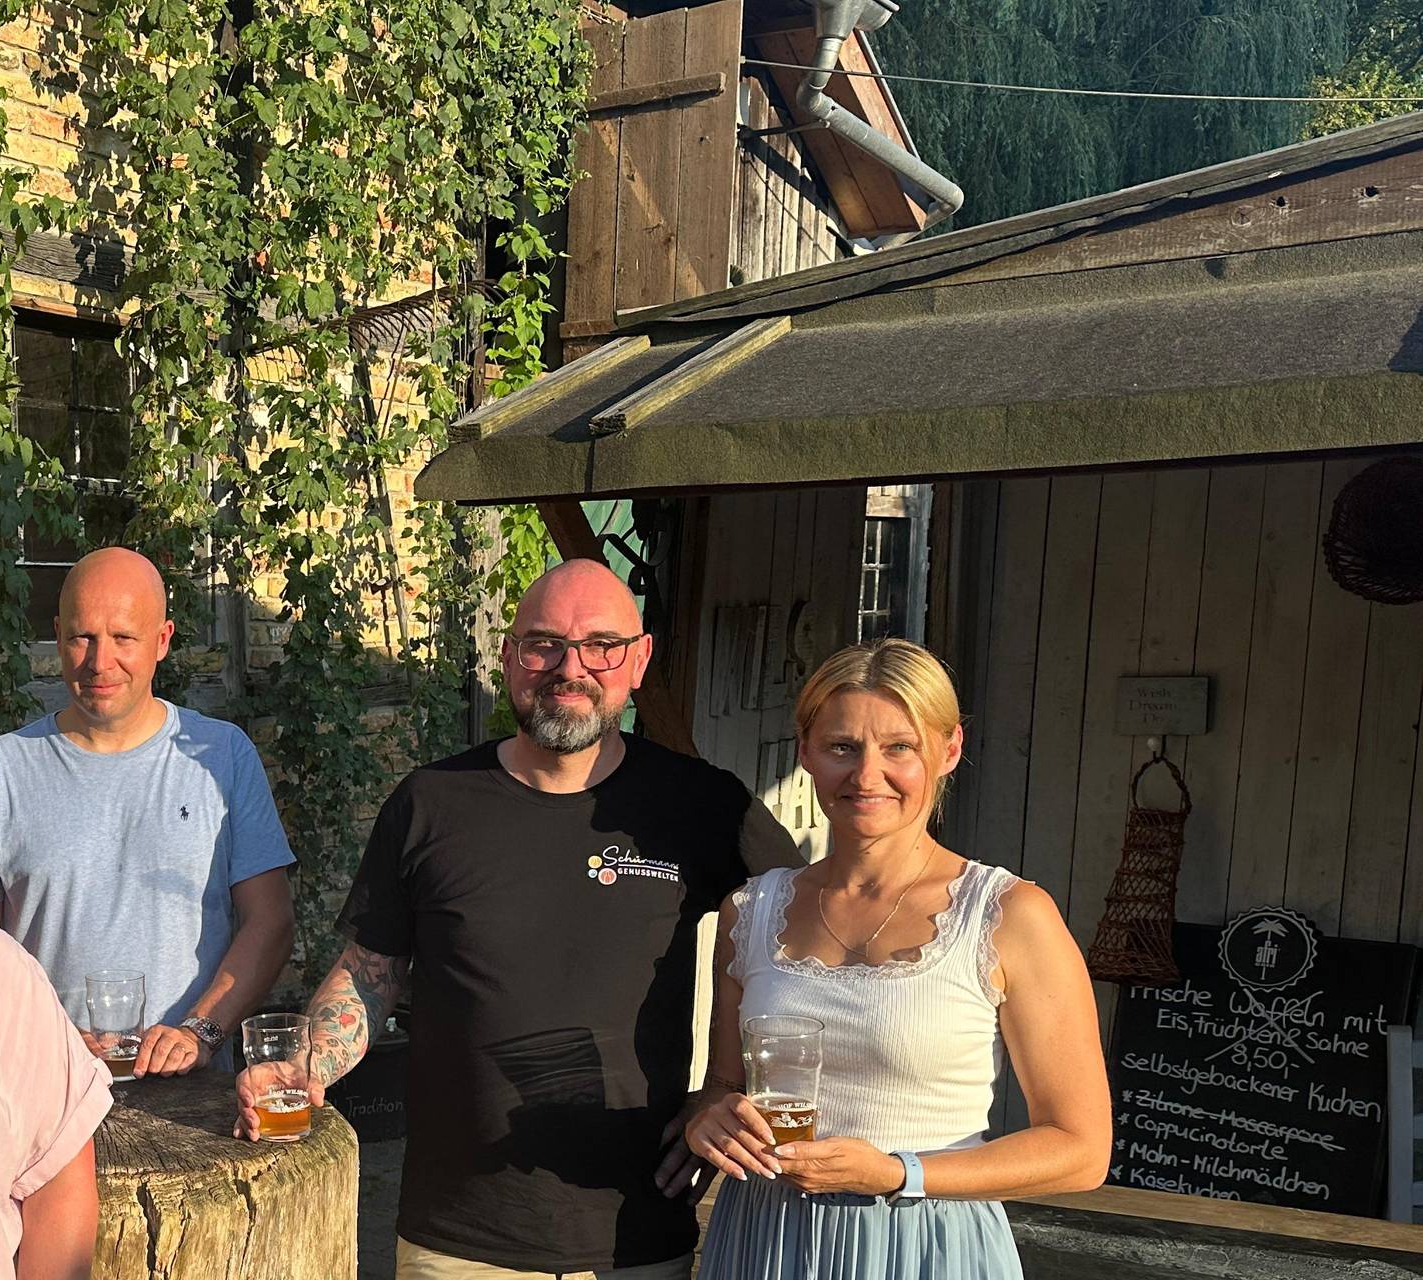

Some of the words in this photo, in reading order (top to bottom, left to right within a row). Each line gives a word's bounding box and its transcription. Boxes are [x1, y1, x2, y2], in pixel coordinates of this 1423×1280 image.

[617, 867, 679, 882] GENUSSWELTEN
[1255, 940, 1278, 964] afri
[1229, 989, 1325, 1029] Waffeln
[1344, 1004, 1388, 1036] mit
[1305, 1031, 1370, 1058] Sahne
[345, 1095, 404, 1119] Tradition
[1307, 1081, 1382, 1124] Kuchen
